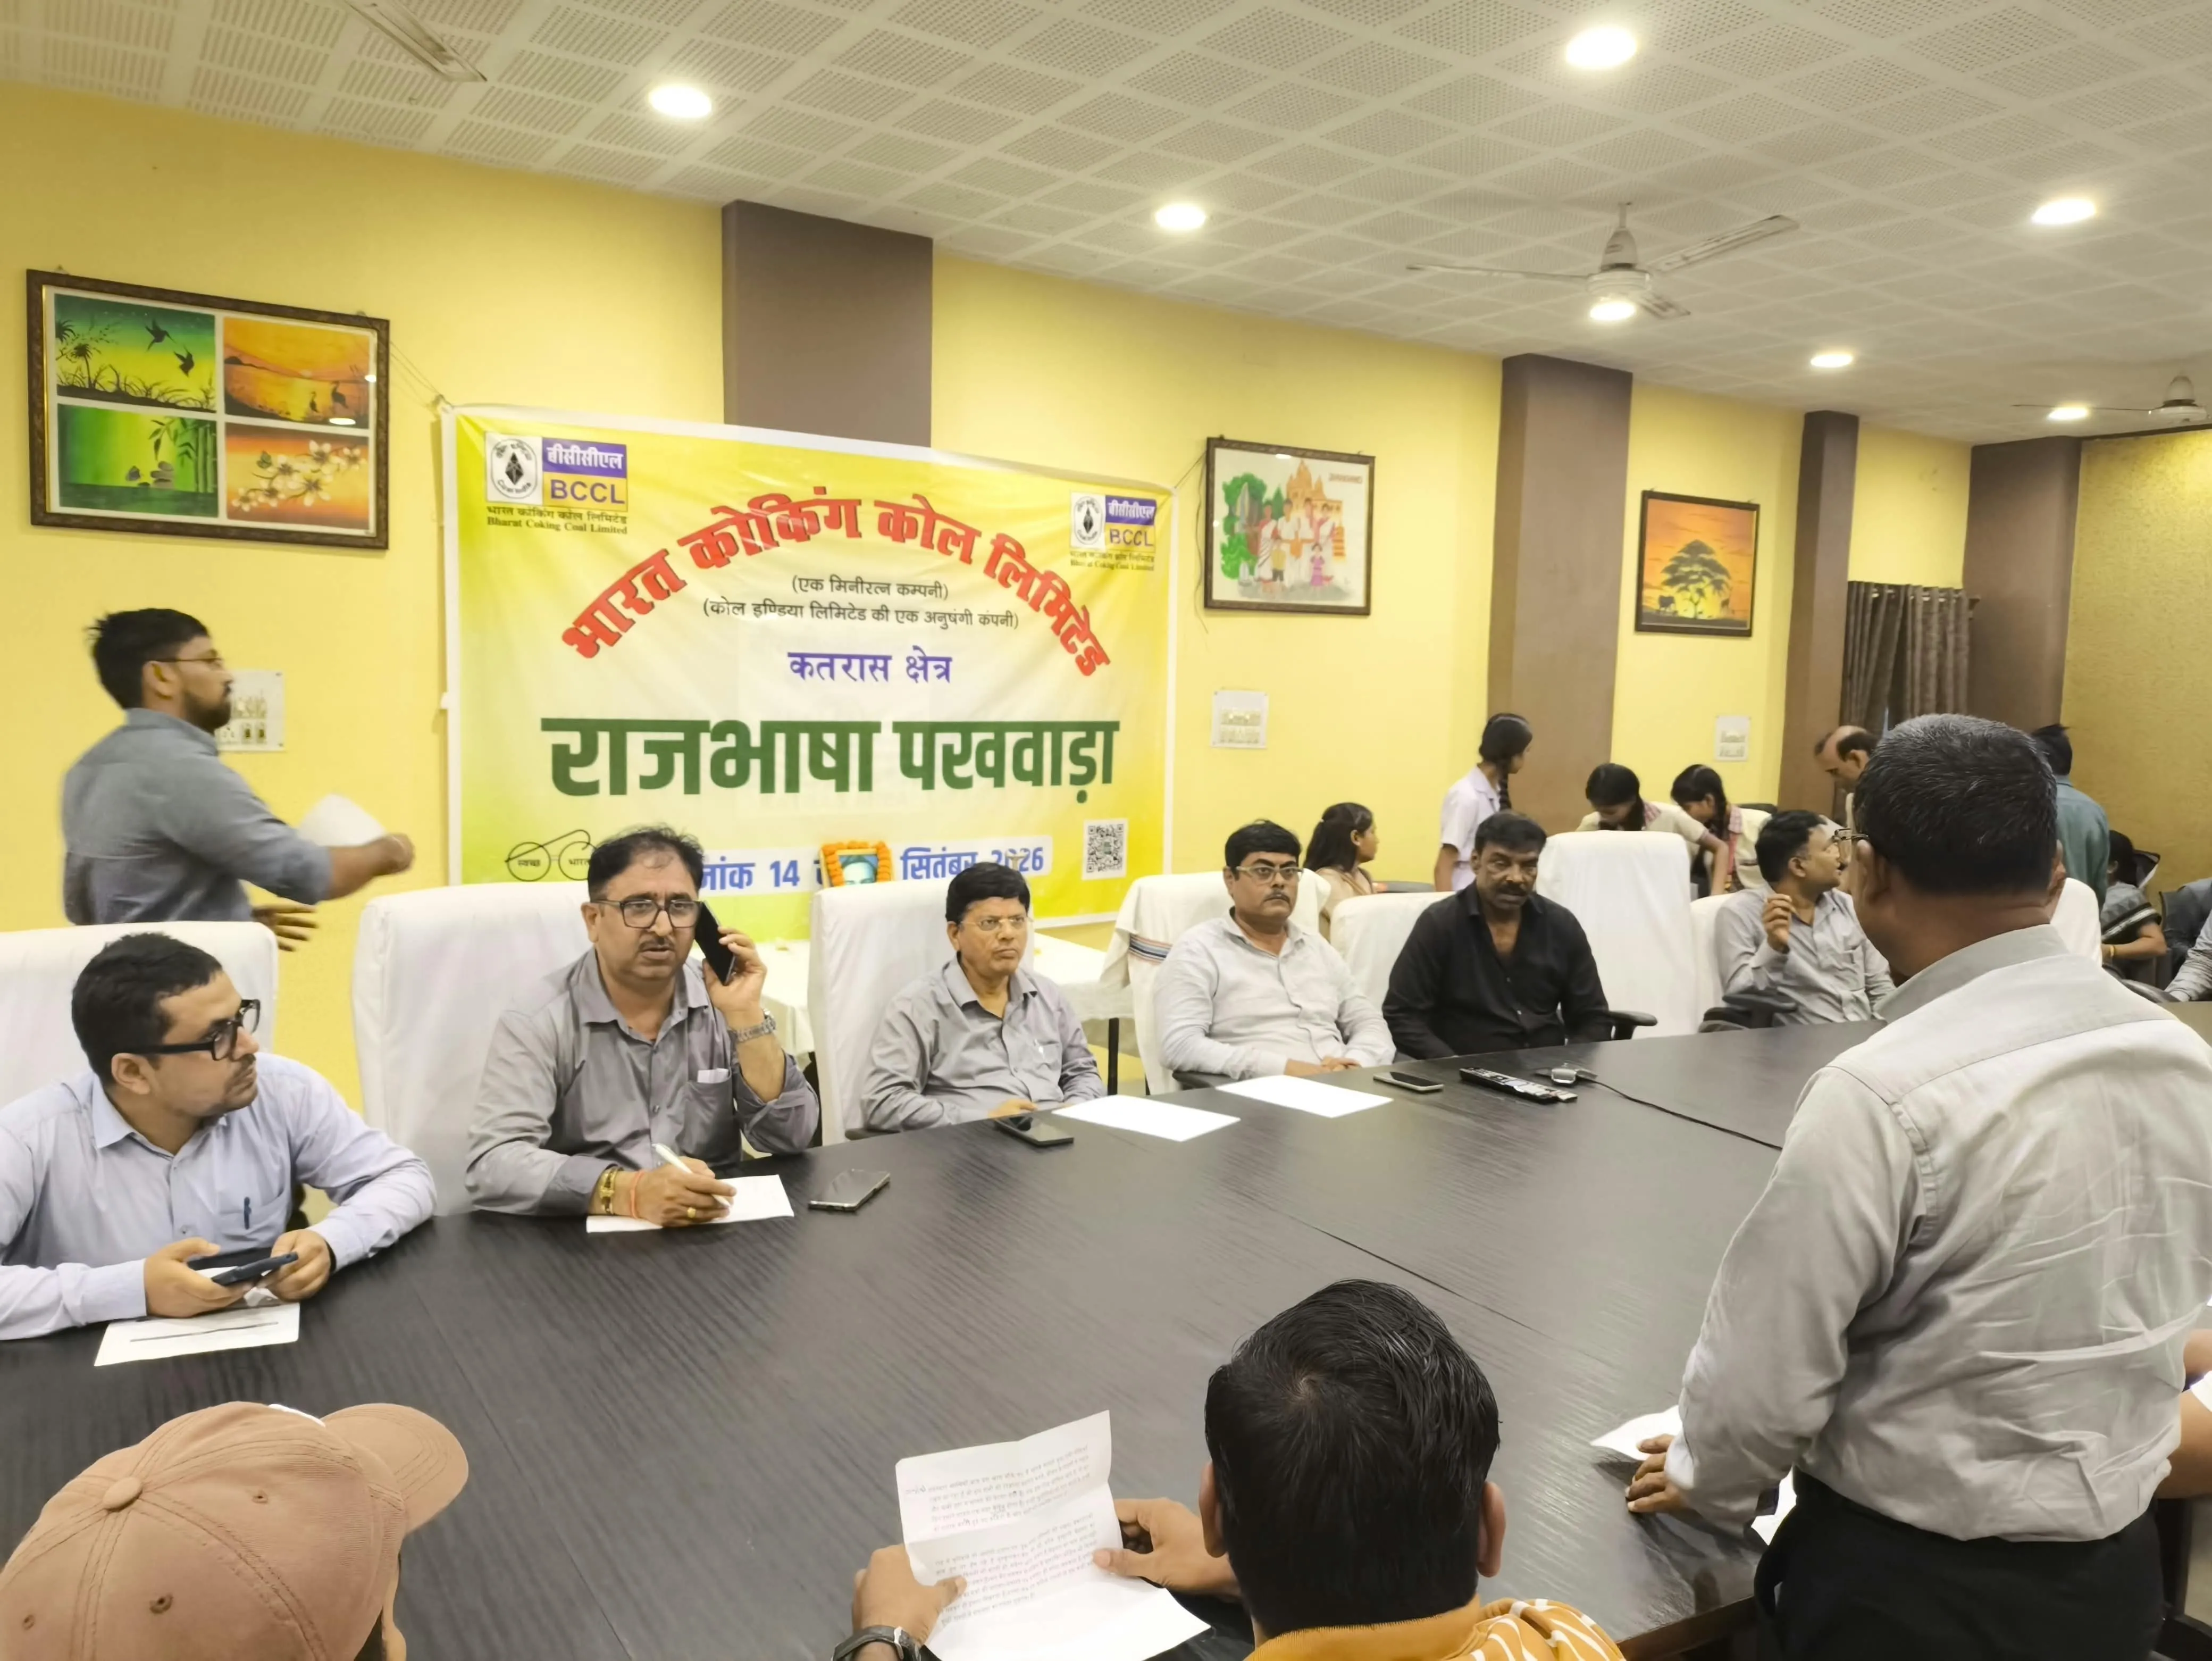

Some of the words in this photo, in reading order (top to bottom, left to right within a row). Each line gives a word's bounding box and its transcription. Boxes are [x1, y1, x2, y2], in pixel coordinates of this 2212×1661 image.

[546, 443, 624, 470] बीसीसीएल
[550, 479, 625, 505] BCCL
[487, 515, 522, 527] Bharat
[525, 518, 561, 531] Coking
[564, 521, 587, 532] Coal
[590, 523, 628, 535] Limited
[1109, 528, 1154, 547] BCCL
[562, 549, 687, 659] भारत
[677, 486, 862, 569] कोकिंग
[874, 494, 981, 564] कोल
[983, 533, 1110, 677] लिमिटेड
[792, 574, 824, 593] (एक
[830, 574, 891, 595] मिनीरत्न
[896, 581, 949, 600] कम्पनी)
[703, 595, 746, 617] (कोल
[751, 598, 804, 618] इण्डिया
[809, 600, 867, 621] लिमिटेड
[871, 606, 890, 622] की
[895, 608, 919, 624] एक
[787, 652, 892, 682] कतरास
[906, 645, 953, 683] क्षेत्र
[541, 718, 882, 797] राजभाषा
[892, 720, 1120, 804] पखवाड़ा
[697, 855, 756, 890] नांक
[769, 859, 800, 887] 14
[900, 847, 979, 880] सितंबर
